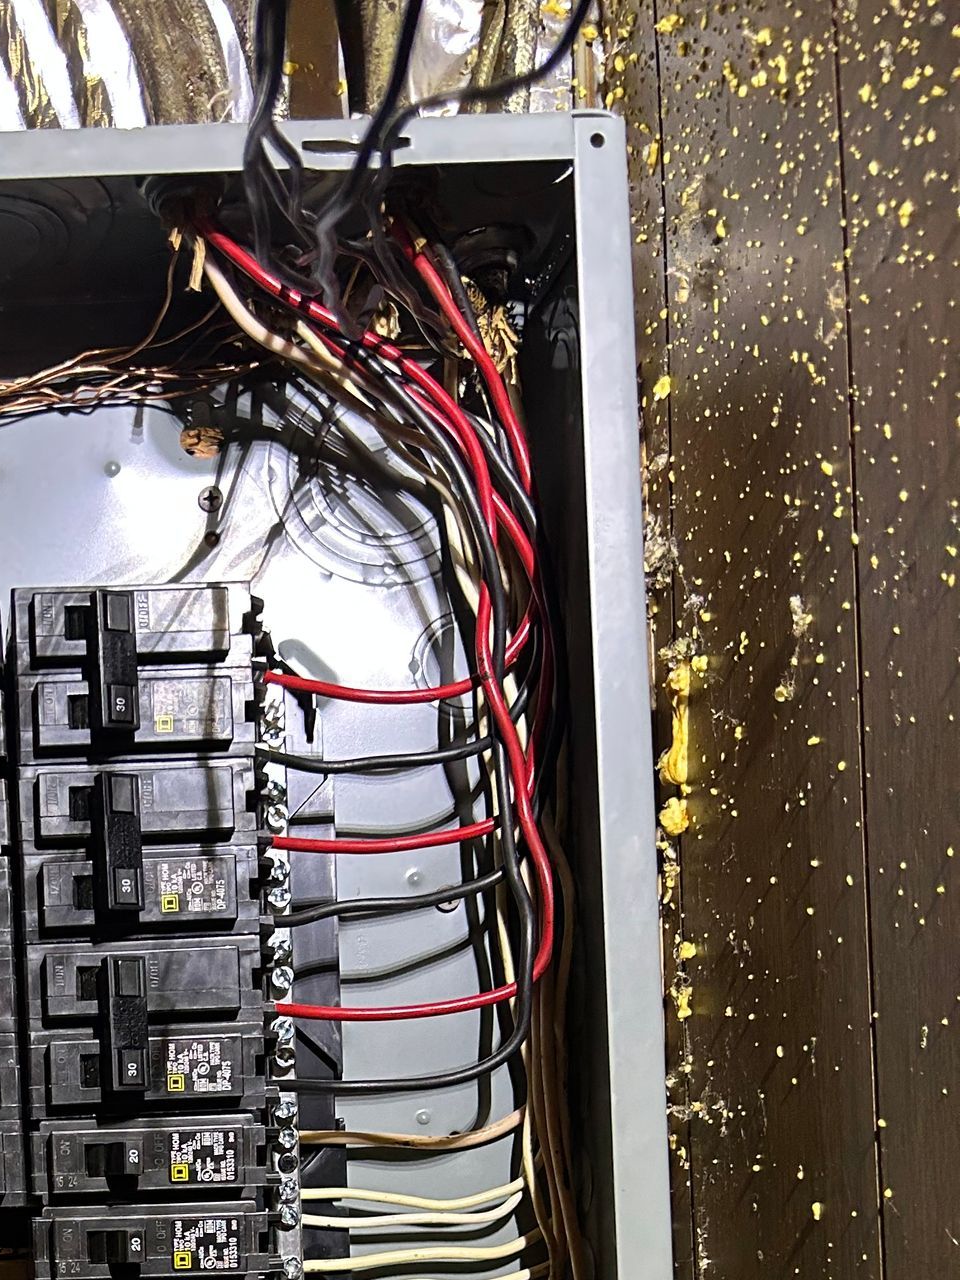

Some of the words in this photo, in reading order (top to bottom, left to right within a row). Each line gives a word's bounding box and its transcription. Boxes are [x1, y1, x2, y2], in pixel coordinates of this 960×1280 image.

[115, 697, 126, 712] 30
[122, 878, 131, 892] 30
[168, 1043, 176, 1060] HOM
[127, 1062, 137, 1077] 30
[172, 1133, 180, 1150] HOM
[129, 1149, 139, 1164] 20
[226, 1149, 235, 1180] 0153310
[155, 1220, 166, 1239] OFF
[131, 1237, 141, 1252] 20
[228, 1237, 238, 1268] 0153310
[71, 1262, 80, 1273] 24
